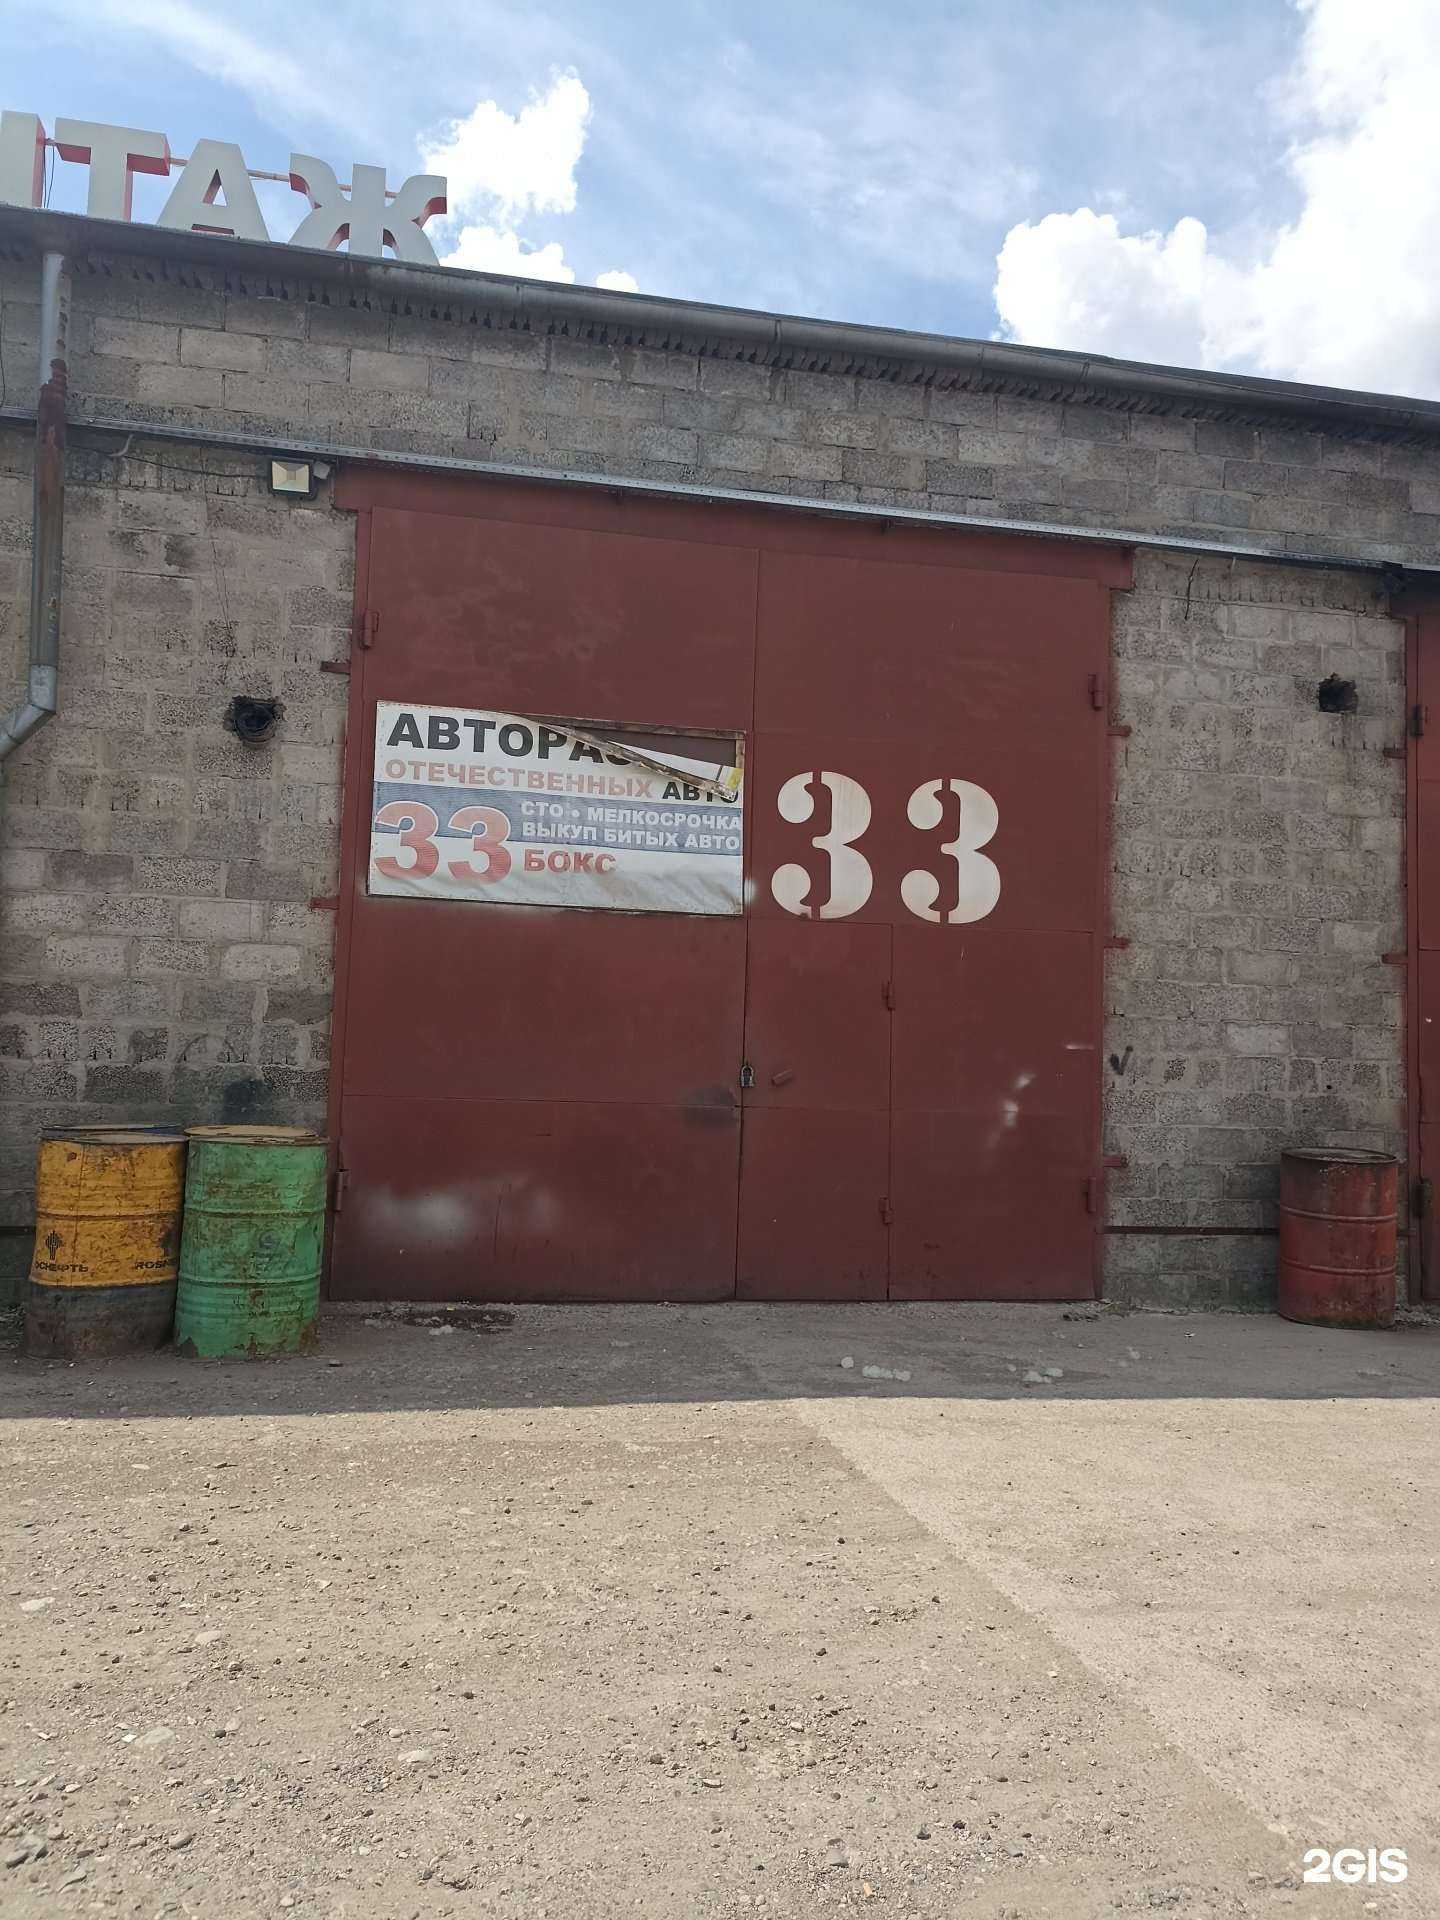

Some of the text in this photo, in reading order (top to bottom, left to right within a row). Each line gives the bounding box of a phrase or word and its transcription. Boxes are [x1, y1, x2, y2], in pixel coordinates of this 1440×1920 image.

[385, 759, 653, 798] ОТЕЧЕСТВЕННЫХ
[521, 801, 741, 830] СТО МЕЛКОСРОЧКА
[373, 801, 512, 884] 33
[522, 822, 740, 850] ВЫКУП БИТЫХ АВТО
[771, 771, 1001, 924] 33
[524, 848, 616, 874] БОКС
